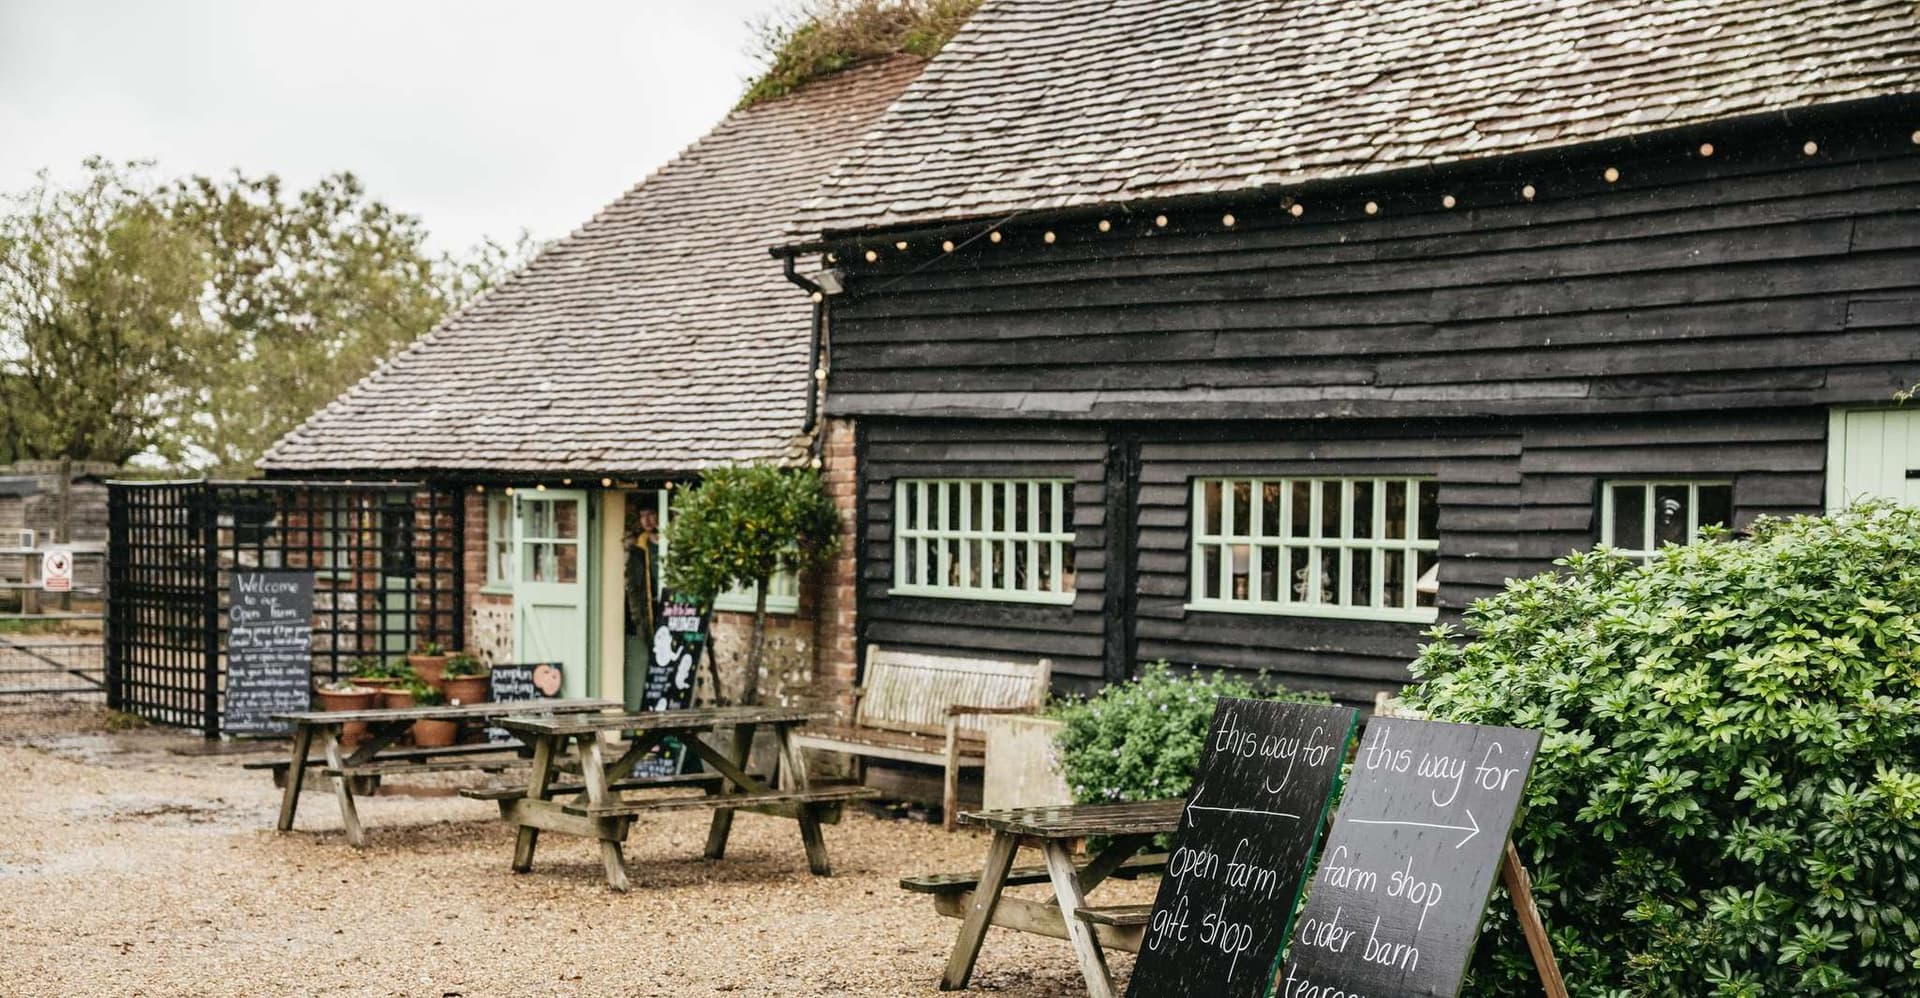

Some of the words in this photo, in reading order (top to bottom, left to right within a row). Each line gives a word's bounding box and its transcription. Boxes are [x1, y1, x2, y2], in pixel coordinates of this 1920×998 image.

[230, 604, 261, 627] Open
[270, 602, 297, 618] Farm
[237, 573, 299, 593] Welcome
[244, 594, 257, 605] to
[491, 667, 533, 687] pumpkin
[1215, 712, 1256, 759] this
[1260, 735, 1300, 793] way
[1301, 726, 1335, 768] for
[1366, 726, 1412, 773] this
[1417, 753, 1466, 807] way
[1475, 742, 1520, 791] for
[1170, 846, 1219, 895] open
[1225, 838, 1277, 899] farm
[1324, 845, 1377, 893] farm
[1387, 856, 1442, 931] shop
[1149, 895, 1190, 950] gift
[1200, 899, 1253, 983] shop
[1301, 906, 1356, 953] cider
[1362, 916, 1419, 972] barn
